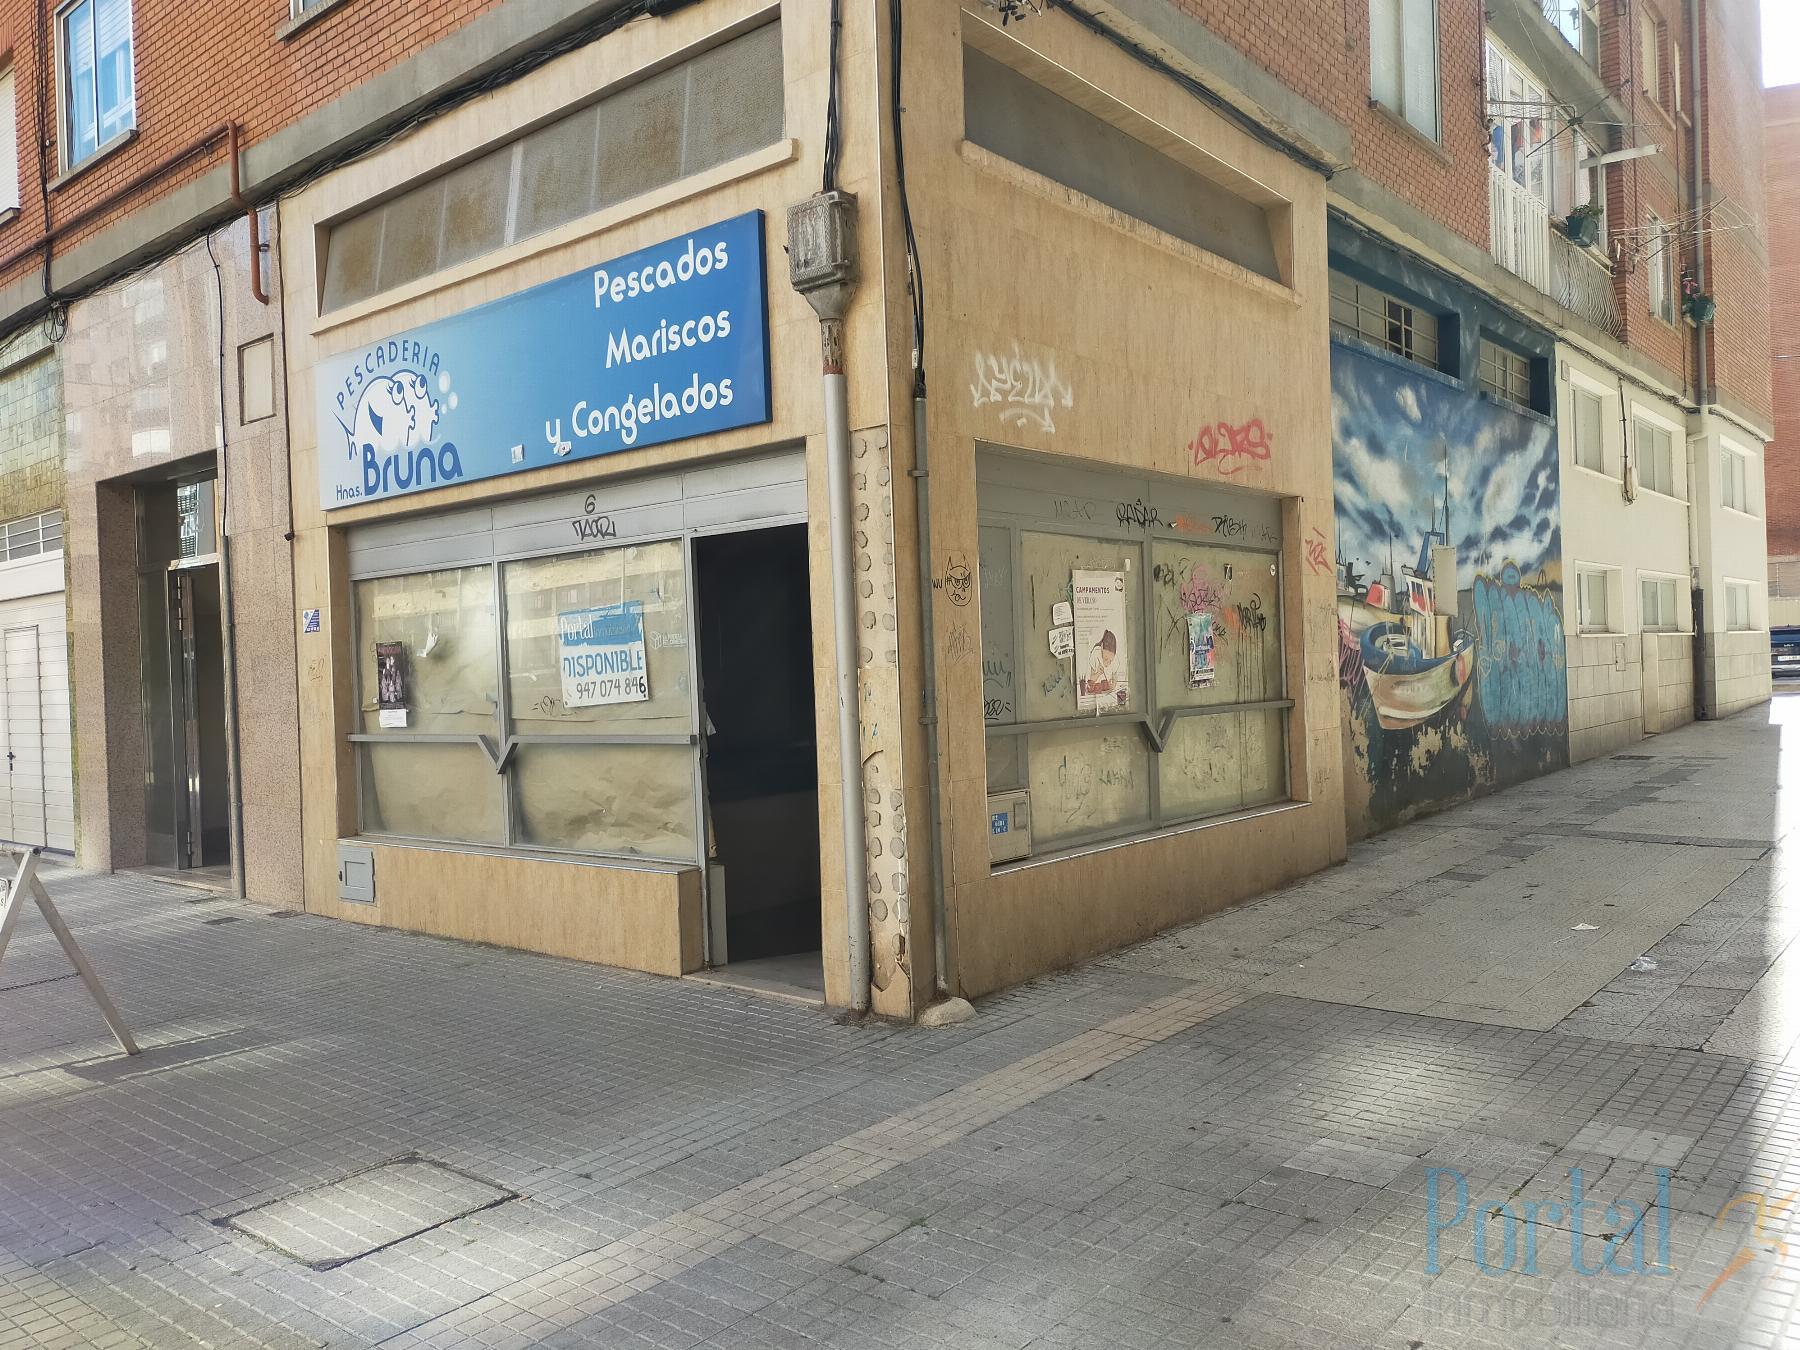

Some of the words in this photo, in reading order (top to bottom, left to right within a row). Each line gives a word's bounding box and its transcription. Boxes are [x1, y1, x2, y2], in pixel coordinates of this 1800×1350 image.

[594, 238, 729, 309] Pescados
[605, 310, 731, 369] Mariscos
[336, 339, 440, 411] PESCADERIA
[545, 418, 562, 455] y
[571, 366, 734, 445] Congelados
[335, 484, 363, 501] Hnas.
[362, 442, 464, 497] Bruna
[1075, 586, 1110, 594] CAMPAMENTOS
[560, 614, 593, 641] Portal
[563, 648, 643, 678] DISPONIBLE
[576, 681, 597, 699] 947
[600, 678, 621, 698] 074
[624, 676, 647, 695] 846
